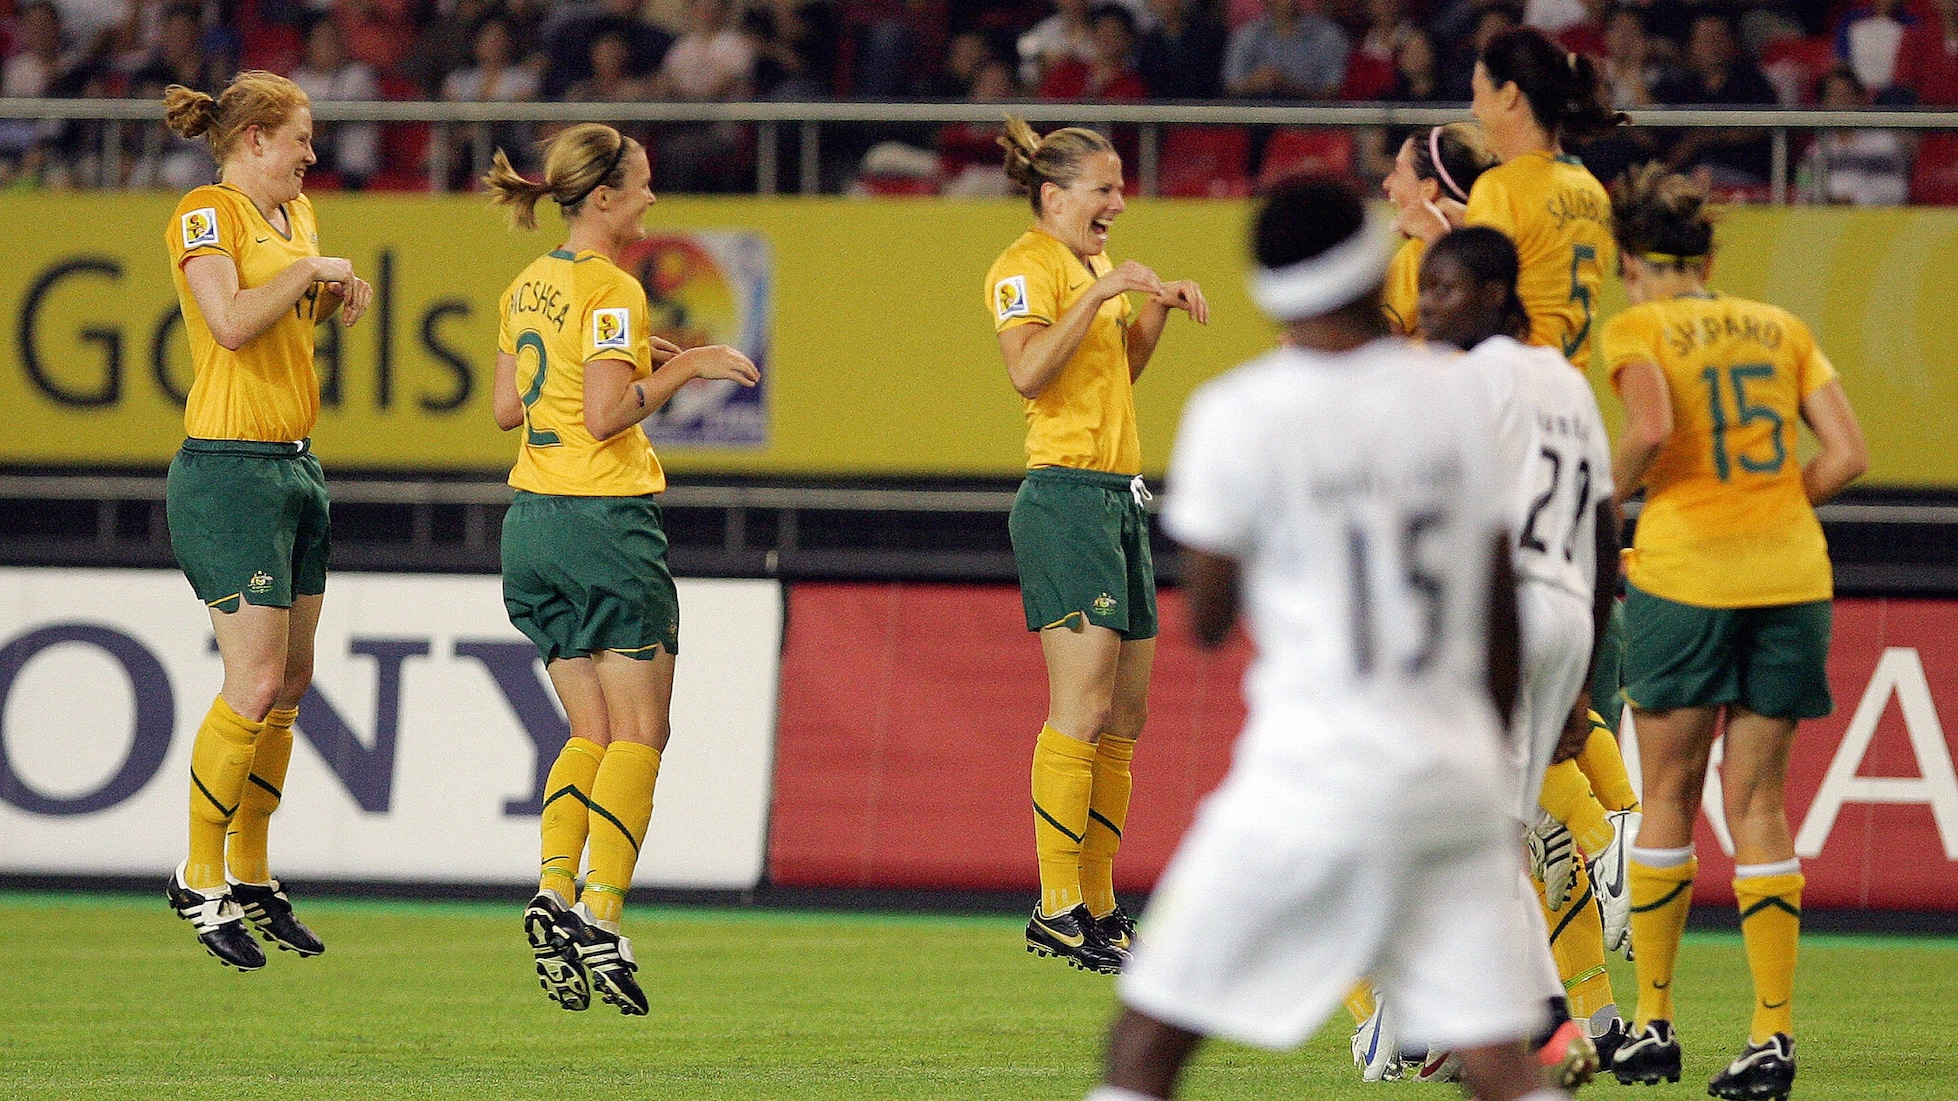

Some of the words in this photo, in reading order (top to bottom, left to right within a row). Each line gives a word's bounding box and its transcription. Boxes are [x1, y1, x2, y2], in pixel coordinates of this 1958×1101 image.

[1562, 244, 1596, 358] 5
[515, 328, 563, 447] 2
[1702, 365, 1786, 483] 15
[1346, 508, 1446, 680] 15
